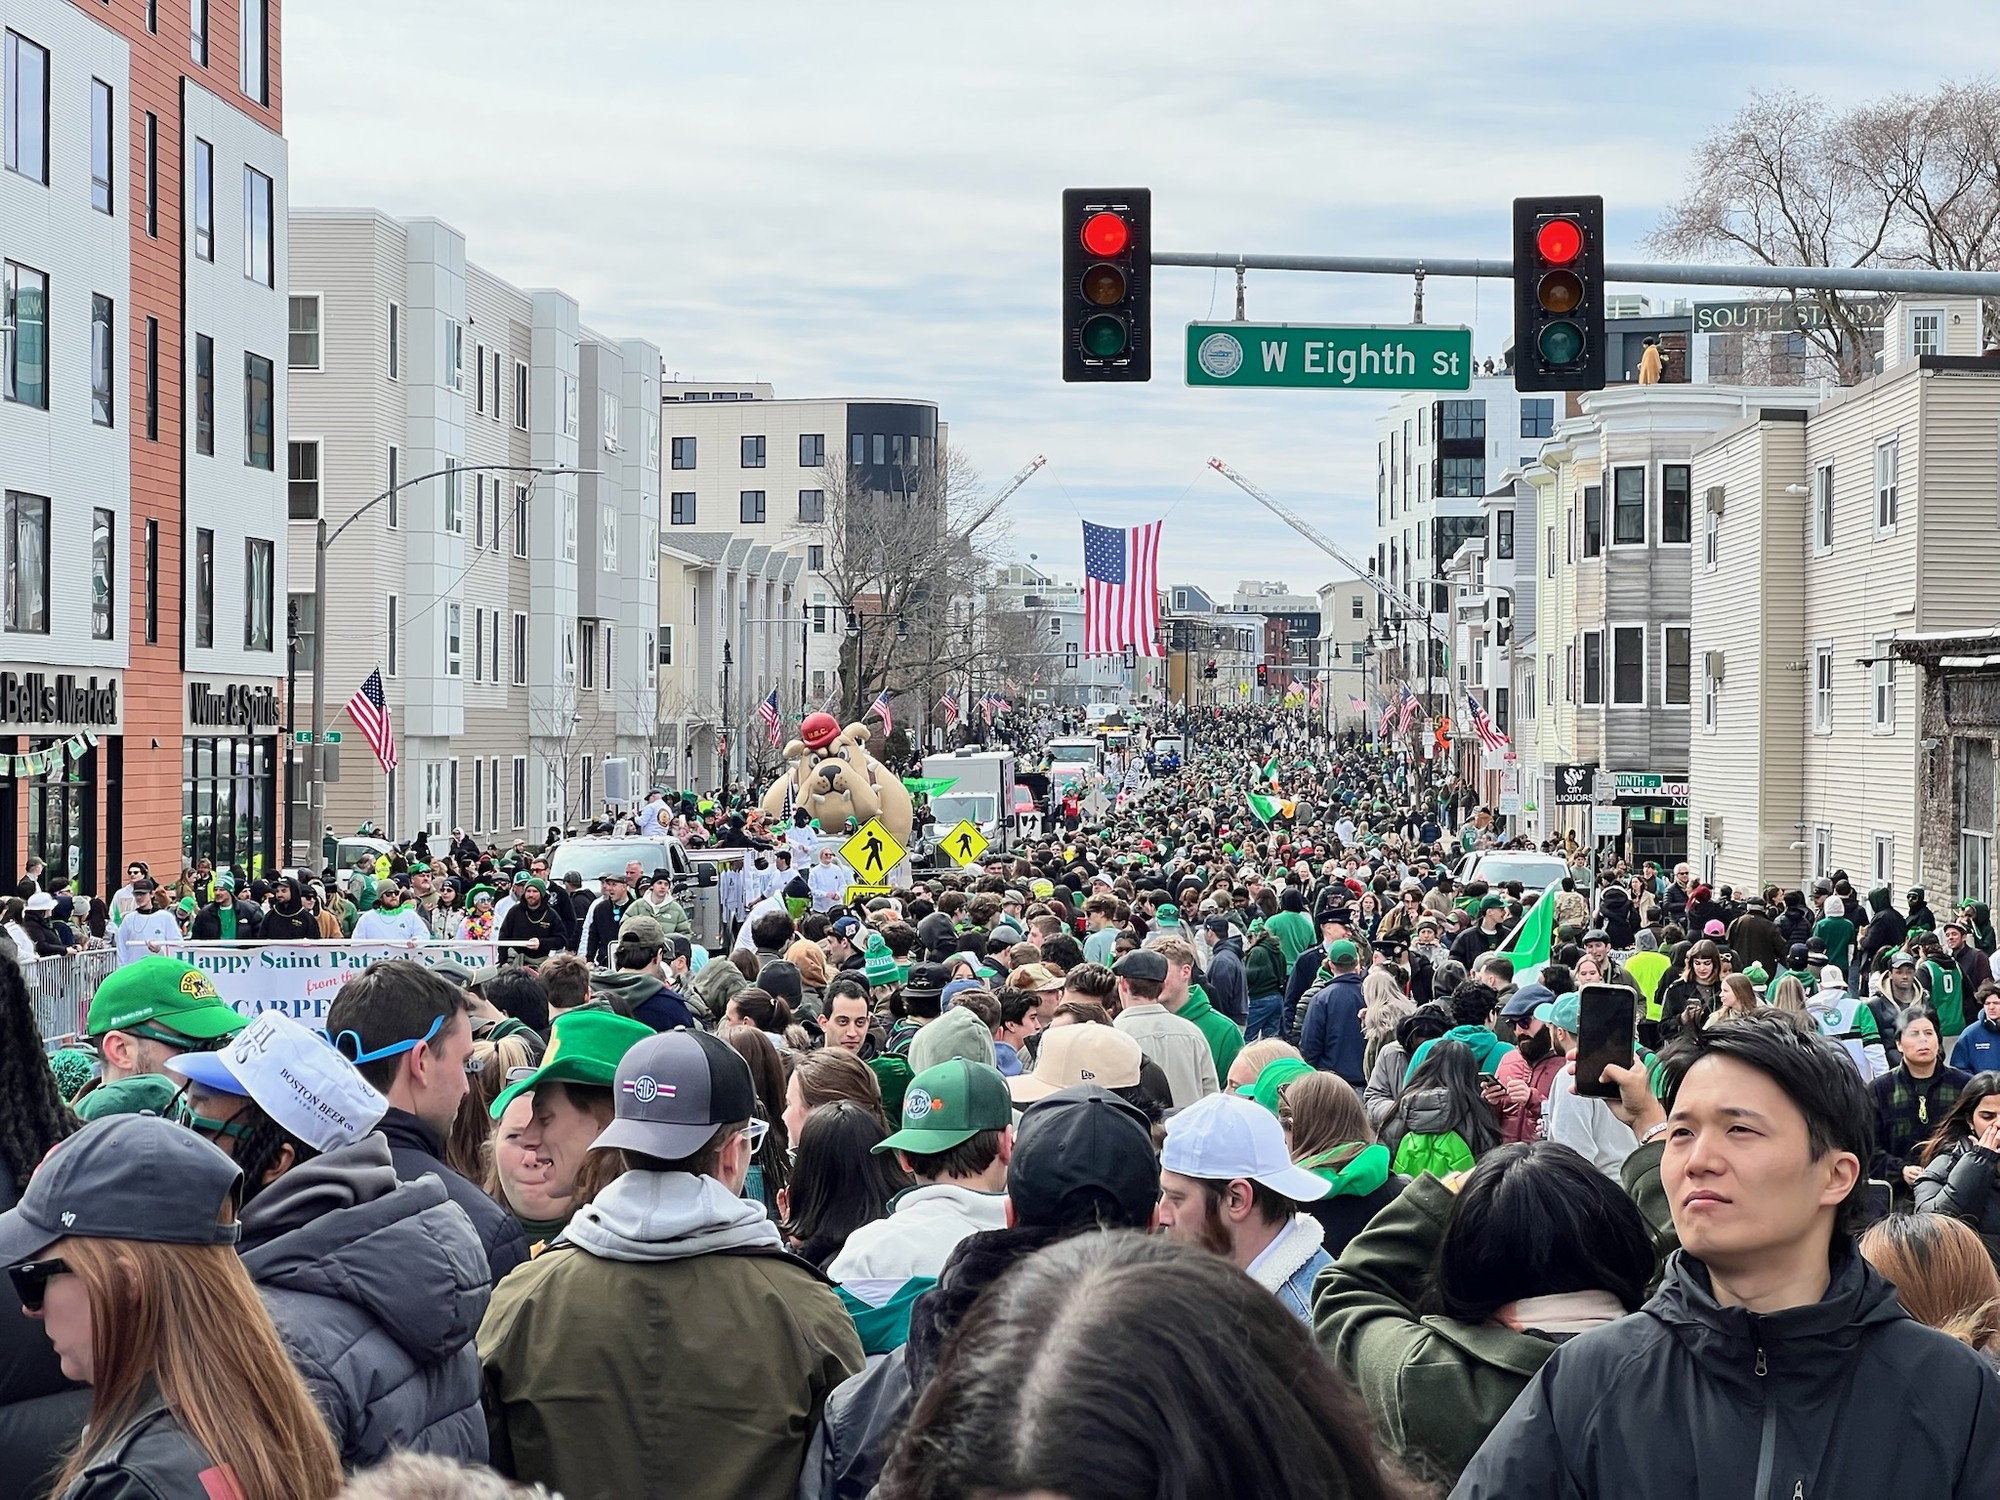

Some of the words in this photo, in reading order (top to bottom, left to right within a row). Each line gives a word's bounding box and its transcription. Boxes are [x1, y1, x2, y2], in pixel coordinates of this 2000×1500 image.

[1698, 307, 1783, 328] SOUTH
[1797, 304, 1884, 327] STANDA
[1261, 341, 1288, 372] W
[1304, 341, 1415, 384] Eighth
[1432, 352, 1460, 376] St
[1, 672, 56, 724] Bell's
[56, 674, 118, 725] Market
[189, 683, 228, 725] Wine
[228, 684, 240, 724] &
[239, 684, 280, 727] Spirits
[1567, 786, 1583, 794] CITY
[1615, 775, 1645, 786] NINTH
[1660, 785, 1689, 796] LIQU
[1557, 794, 1592, 802] LIQUORS
[176, 951, 253, 974] Happy
[260, 950, 322, 969] Saint
[306, 977, 337, 996] from
[1942, 974, 1954, 994] 0
[231, 999, 332, 1018] CARPE
[280, 1068, 321, 1106] BOSTON
[318, 1103, 346, 1125] BEER
[637, 1079, 655, 1099] SIG
